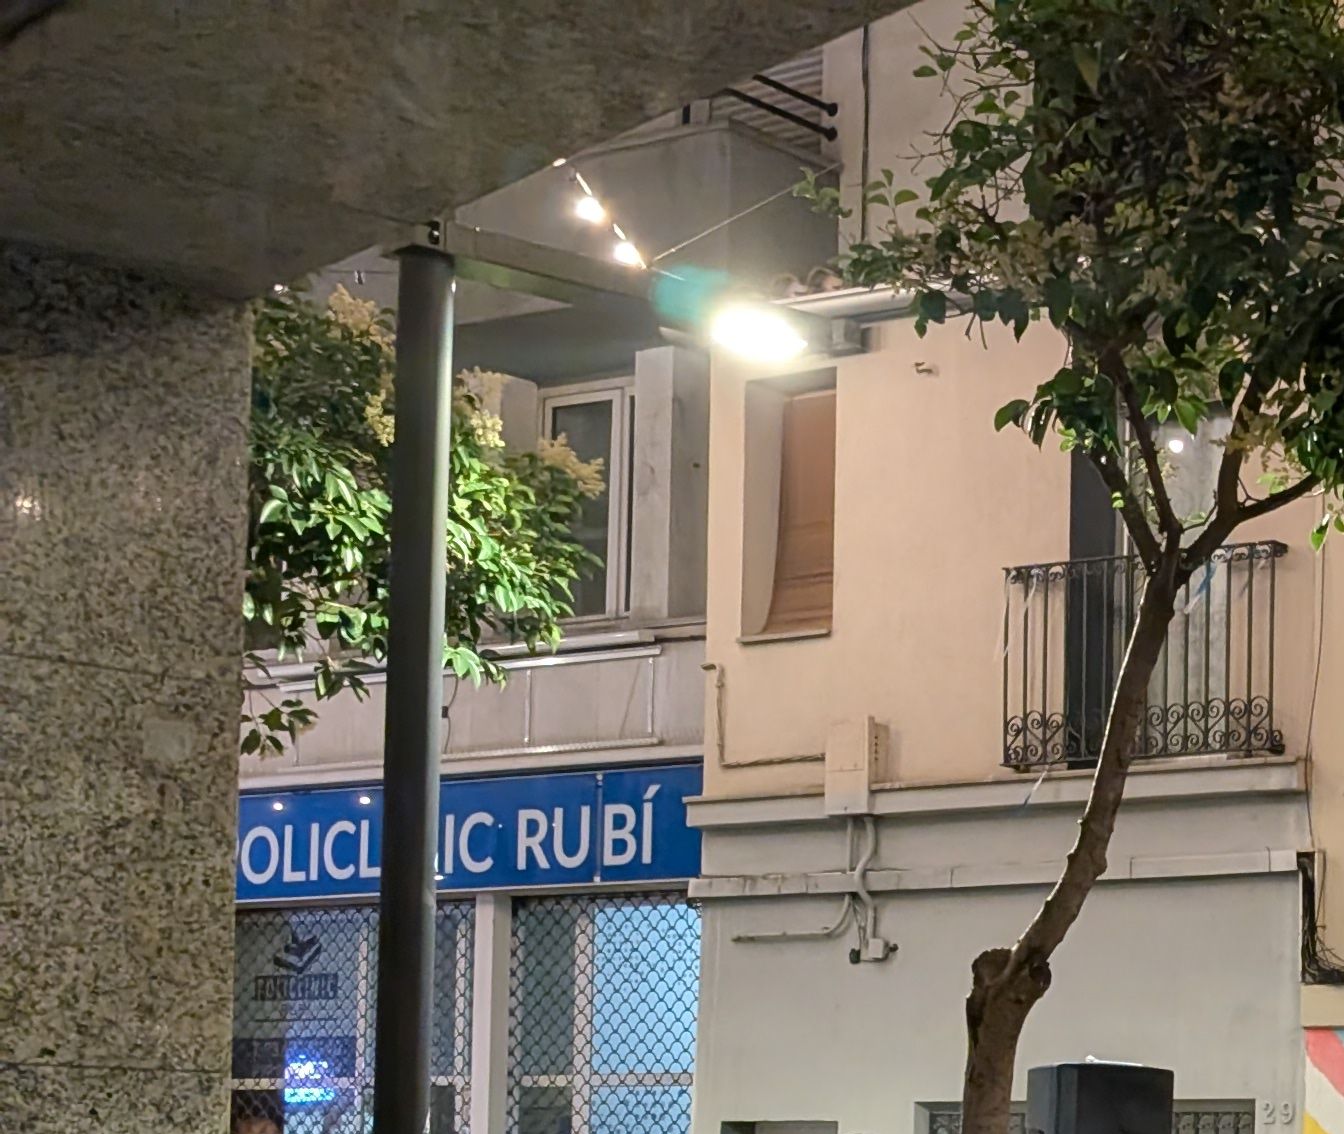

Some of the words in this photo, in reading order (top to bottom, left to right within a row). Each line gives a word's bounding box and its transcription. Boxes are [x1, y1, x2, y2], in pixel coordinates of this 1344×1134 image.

[236, 811, 495, 885] OLICLIC
[516, 784, 661, 871] RUBÍ
[1262, 1100, 1296, 1126] 29
